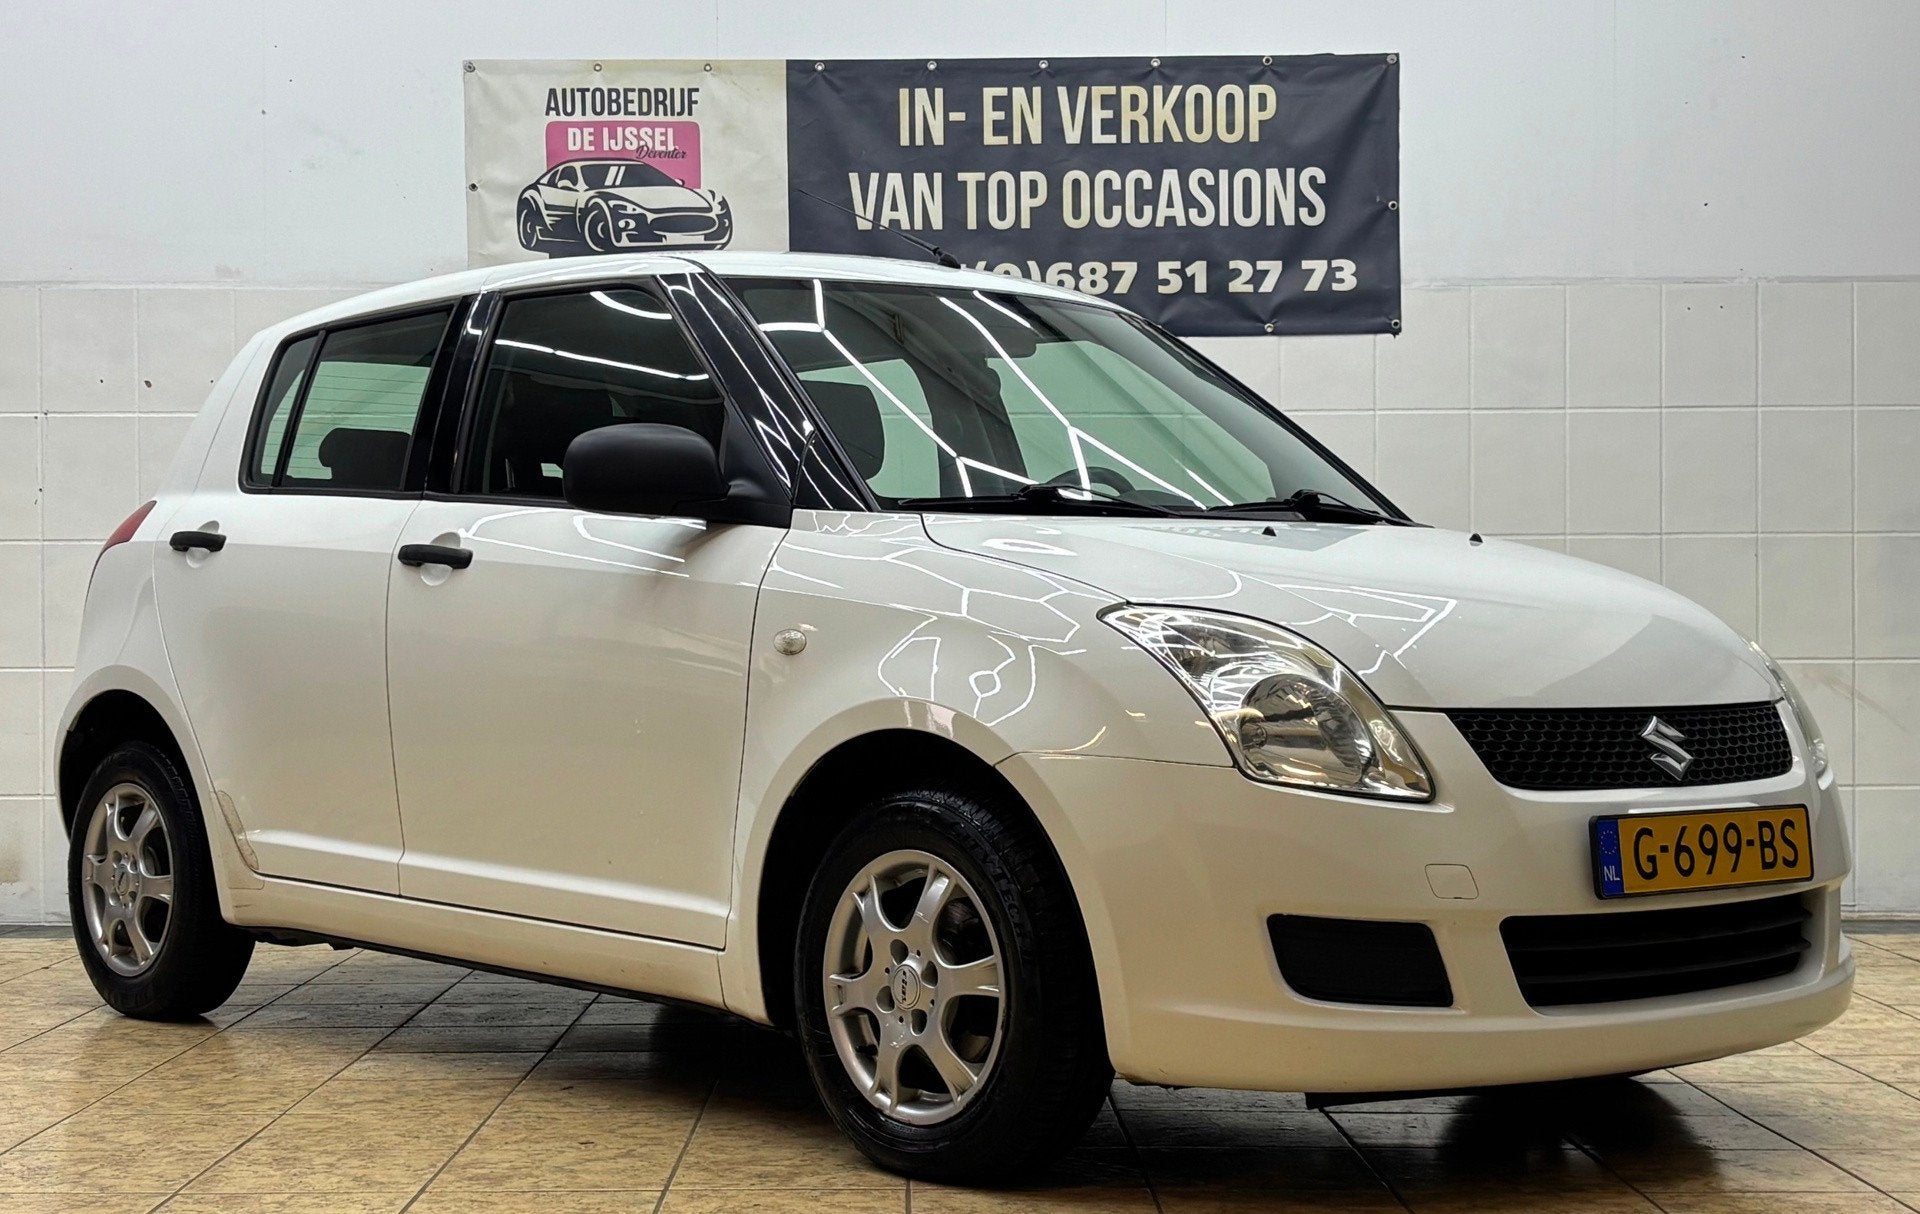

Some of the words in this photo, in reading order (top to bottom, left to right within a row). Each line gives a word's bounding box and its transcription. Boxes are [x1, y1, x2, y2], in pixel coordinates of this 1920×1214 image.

[545, 87, 700, 117] AUTOBEDRIJF
[899, 87, 966, 146] IN-
[983, 86, 1042, 145] EN
[1058, 84, 1277, 144] VERKOOP
[567, 127, 595, 151] DE
[602, 126, 679, 151] IJSSEL
[635, 145, 687, 159] Deventer
[848, 172, 943, 231] VAN
[958, 171, 1048, 230] TOP
[1063, 167, 1326, 229] OCCASIONS
[1157, 260, 1208, 294] 51
[1228, 260, 1283, 293] 27
[1301, 259, 1358, 292] 73
[1633, 818, 1799, 880] G-699-BS
[1603, 865, 1621, 882] NL
